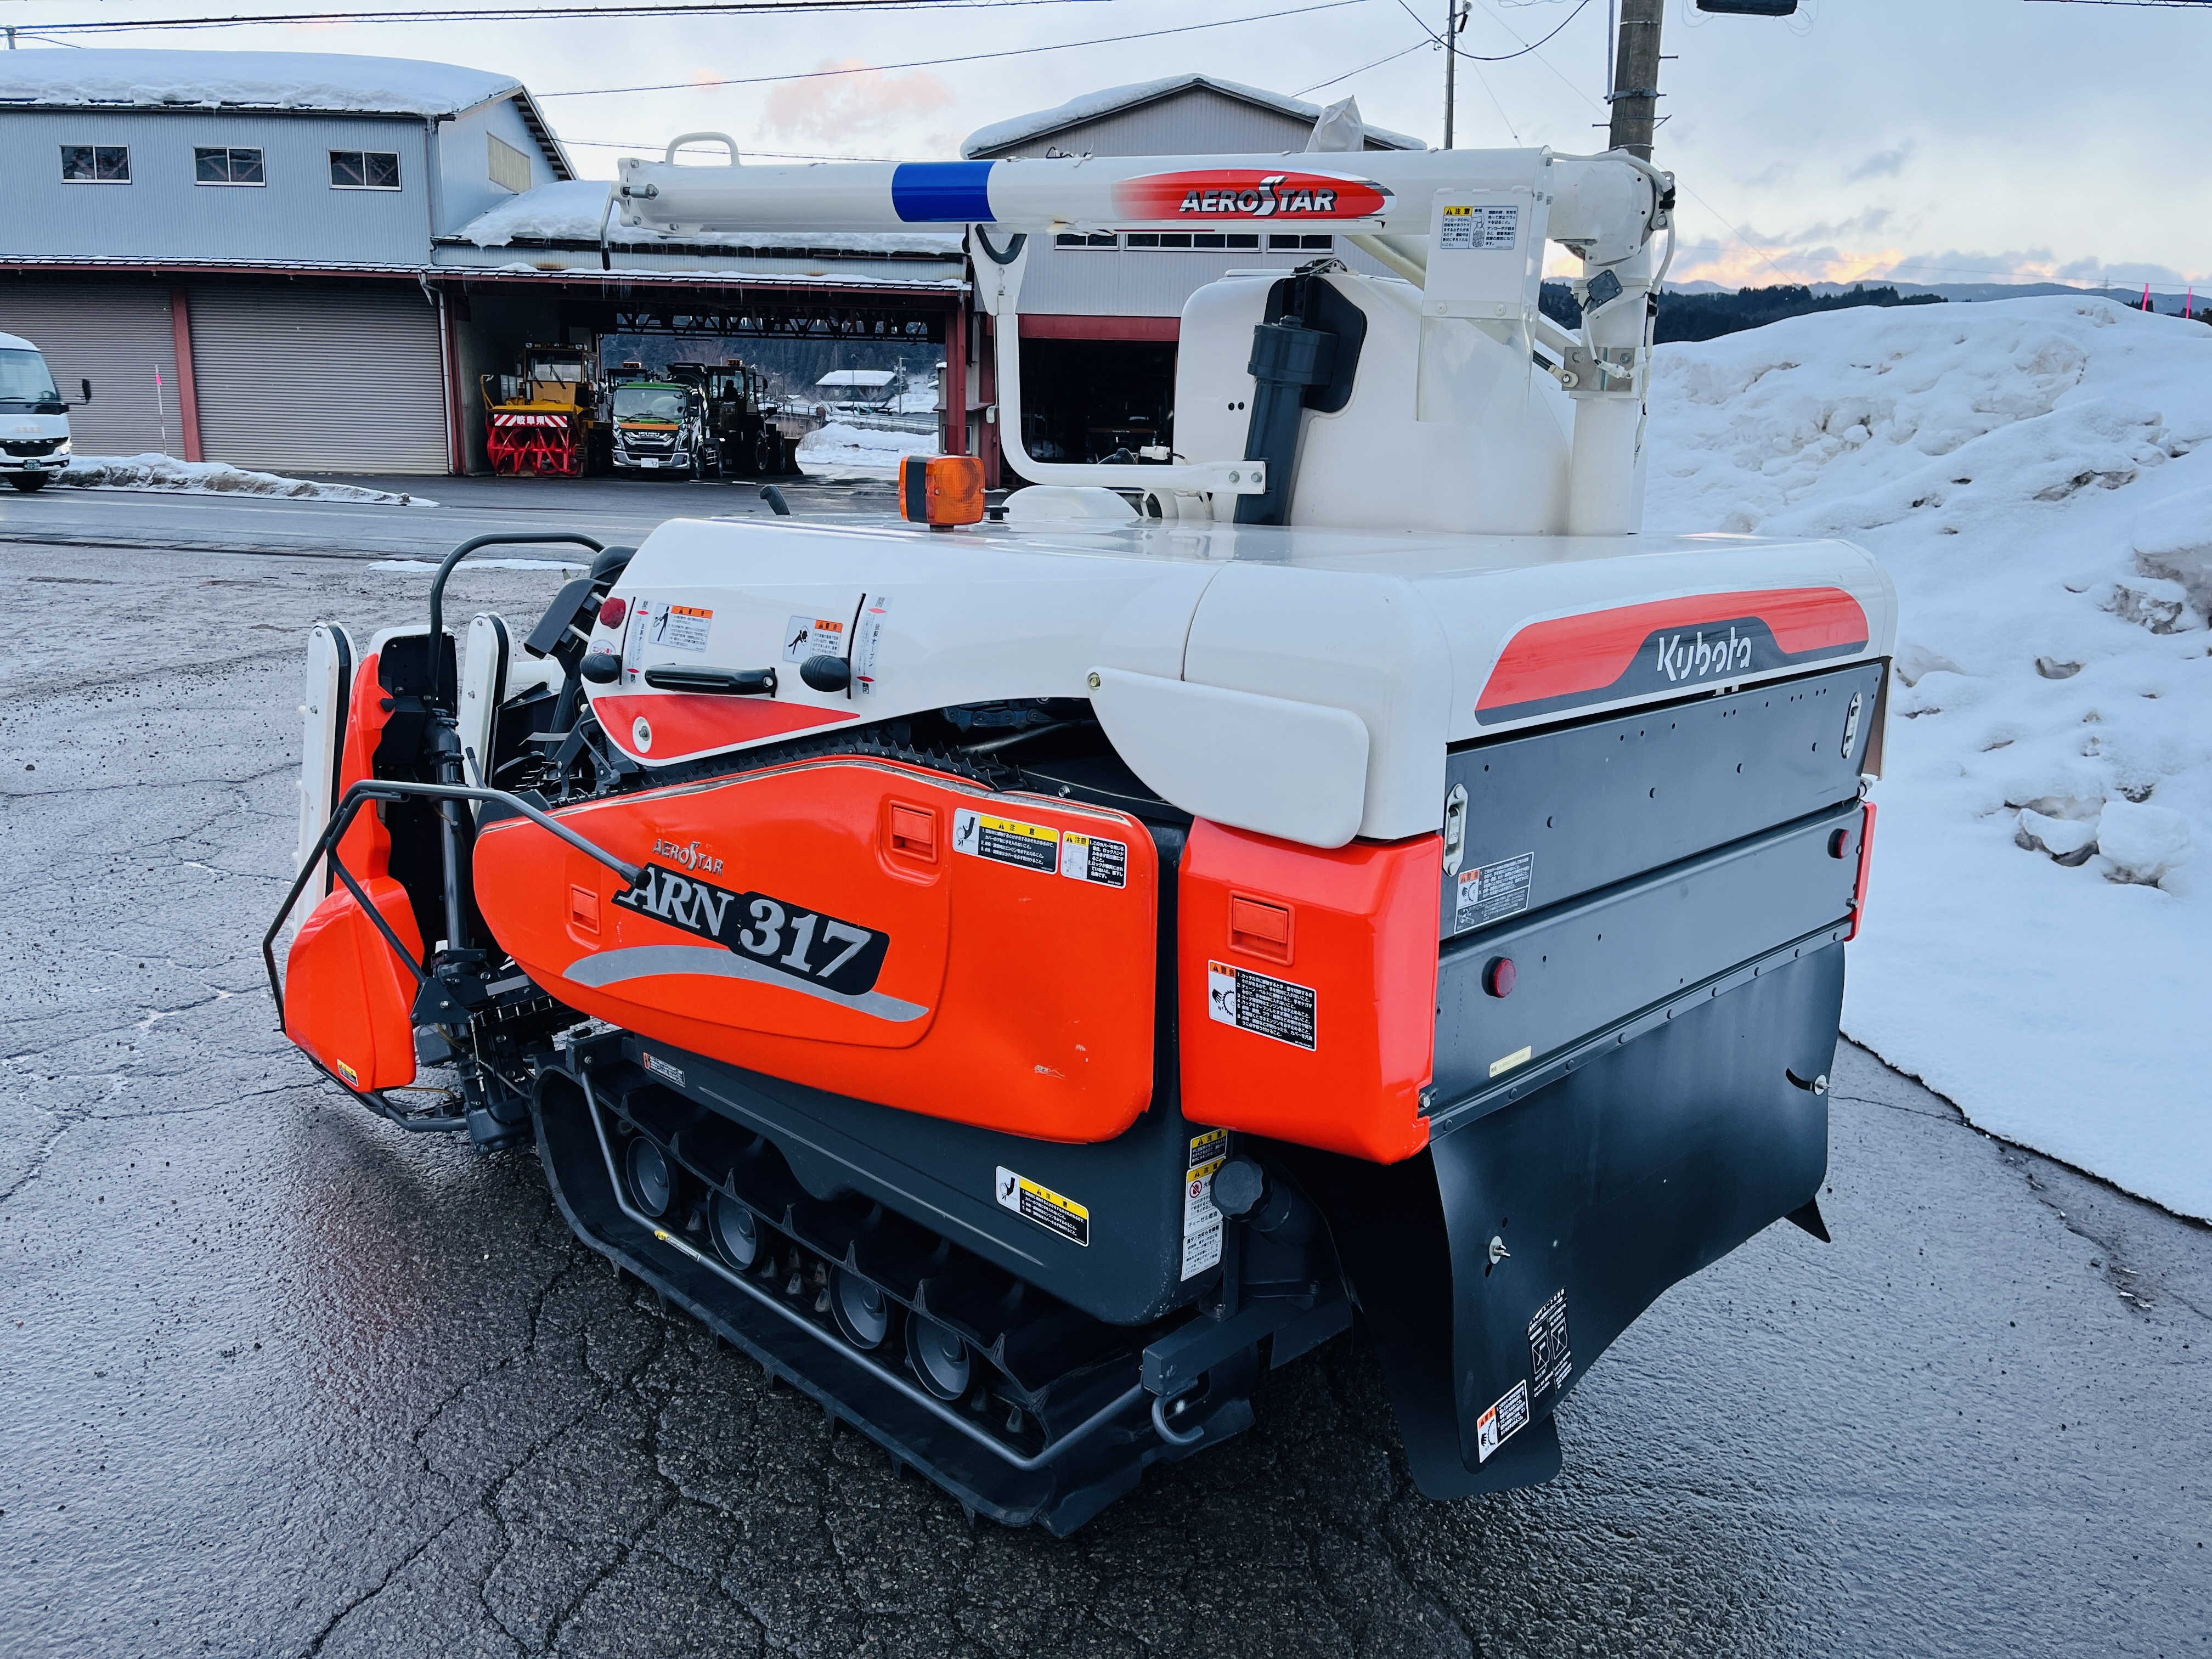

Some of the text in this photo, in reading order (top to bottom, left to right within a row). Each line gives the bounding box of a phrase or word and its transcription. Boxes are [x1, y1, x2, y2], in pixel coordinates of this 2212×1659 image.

[1179, 175, 1337, 216] AEROSTAR
[516, 415, 545, 425] 岐阜県
[1657, 627, 1752, 681] Kubota
[652, 838, 724, 877] AEROSTAR
[1074, 836, 1087, 845] 注意
[617, 867, 873, 978] ARN 317
[1188, 1211, 1218, 1229] ディーゼル軽油
